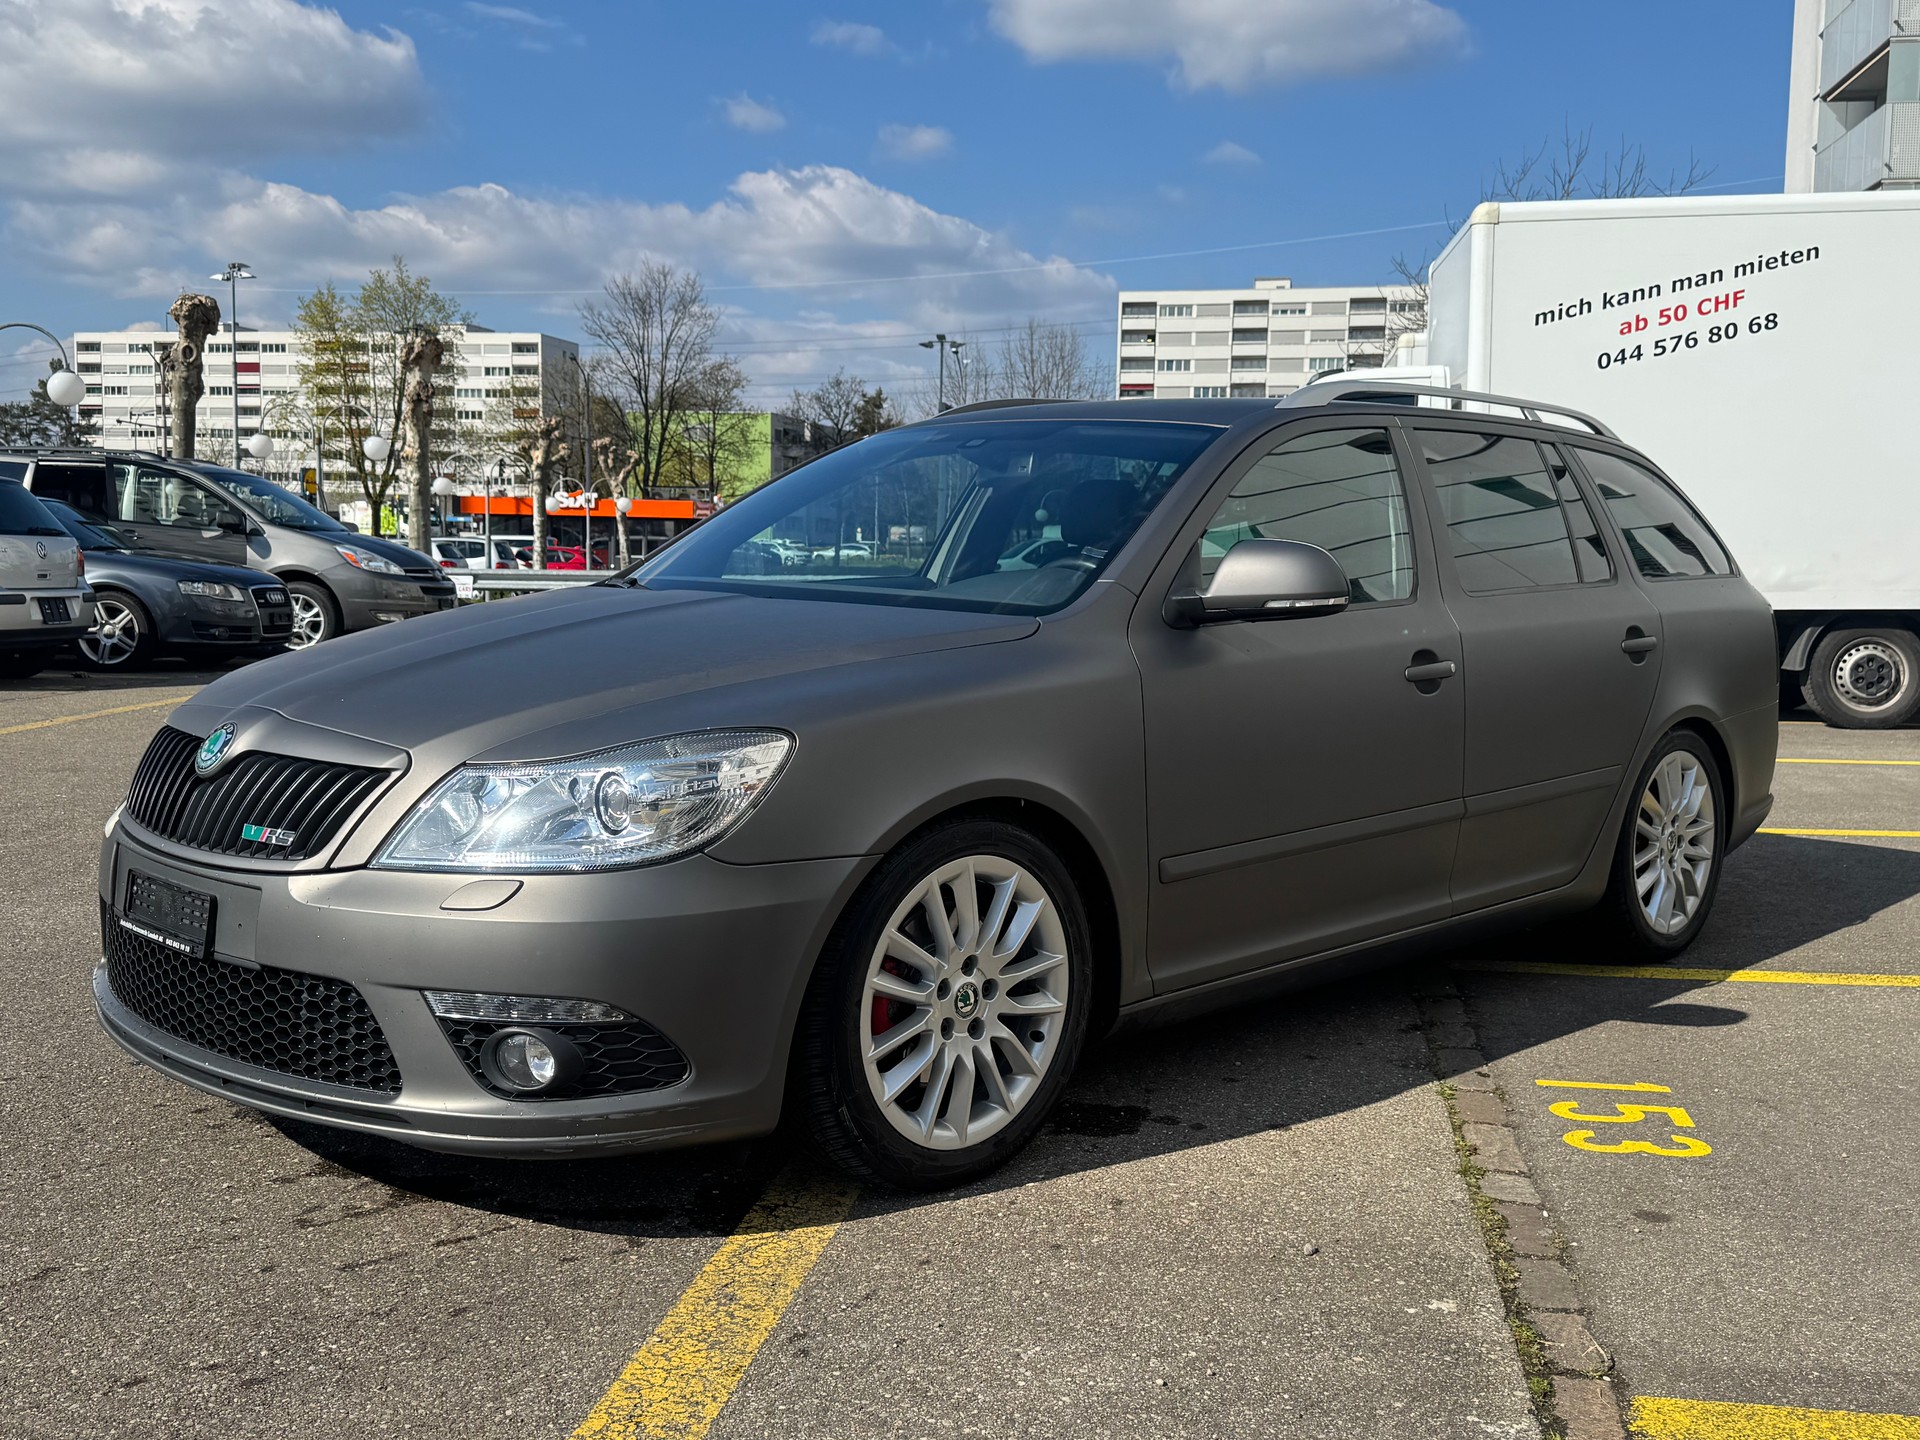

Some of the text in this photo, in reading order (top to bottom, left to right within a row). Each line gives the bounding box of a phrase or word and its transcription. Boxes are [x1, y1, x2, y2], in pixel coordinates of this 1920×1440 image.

[1534, 246, 1820, 327] mich kann man mieten
[1619, 289, 1746, 336] ab 50 CHF
[1597, 312, 1779, 370] 044 576 80 68
[1535, 1079, 1713, 1158] 153
